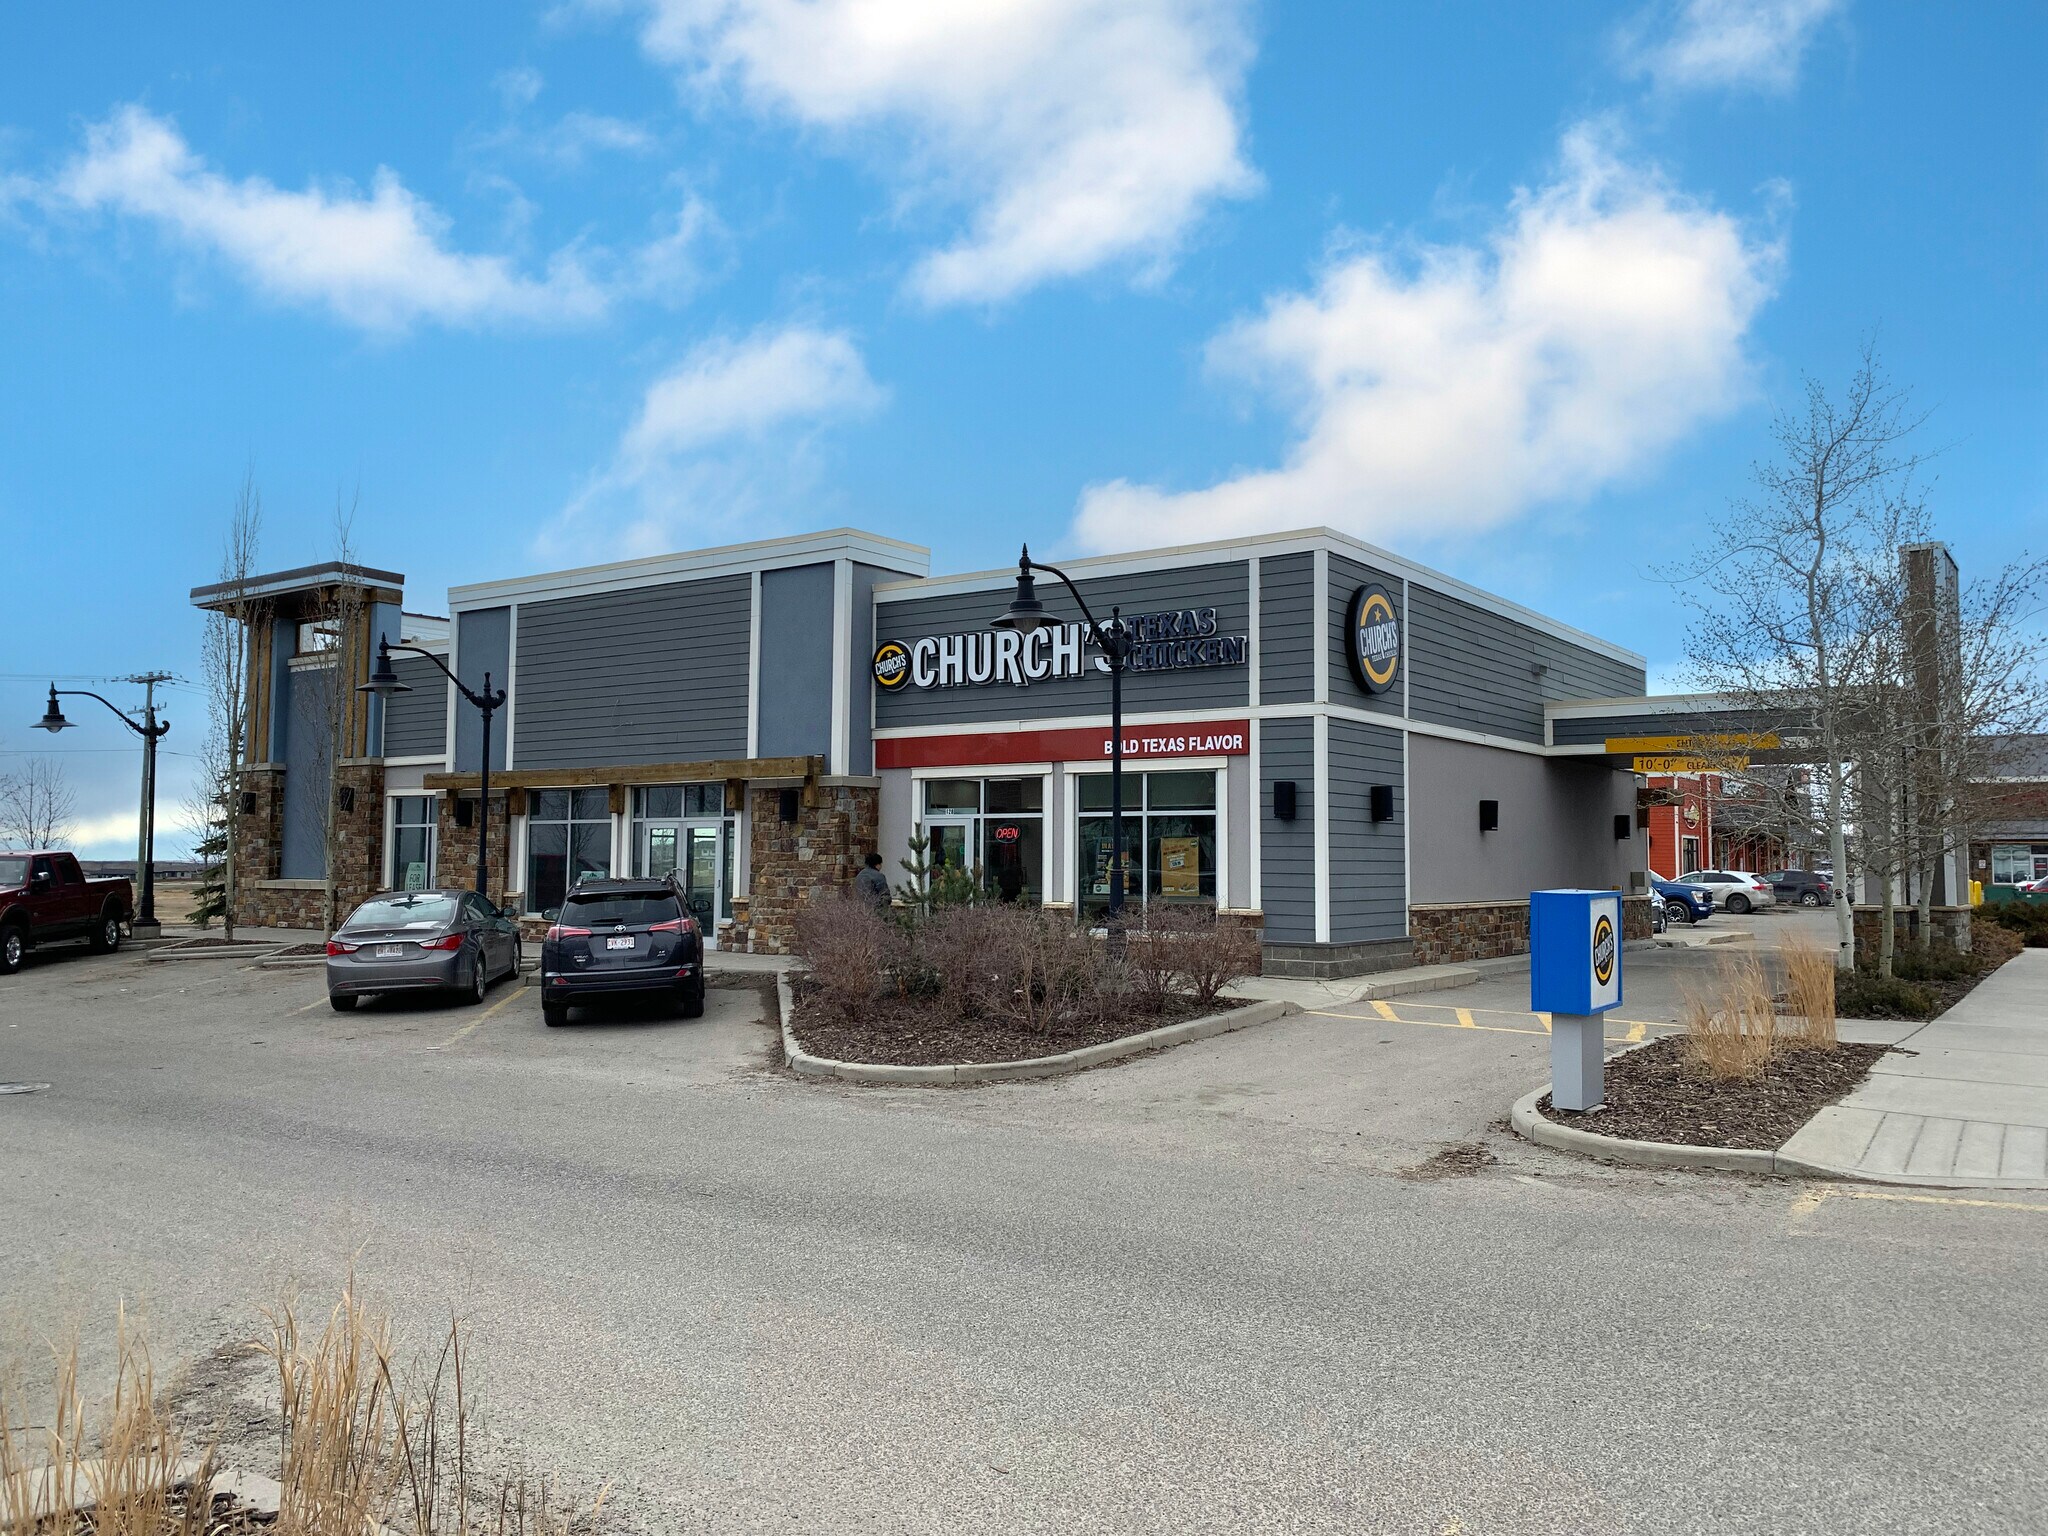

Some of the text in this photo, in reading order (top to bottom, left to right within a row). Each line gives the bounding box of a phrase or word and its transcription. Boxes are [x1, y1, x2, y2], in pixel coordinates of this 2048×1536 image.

[1127, 608, 1216, 642] TEXAS
[1127, 636, 1247, 672] CHICKEN
[1104, 734, 1243, 754] BLD TEXAS FLAVOR
[996, 827, 1019, 839] OPEN
[410, 873, 421, 883] FOR
